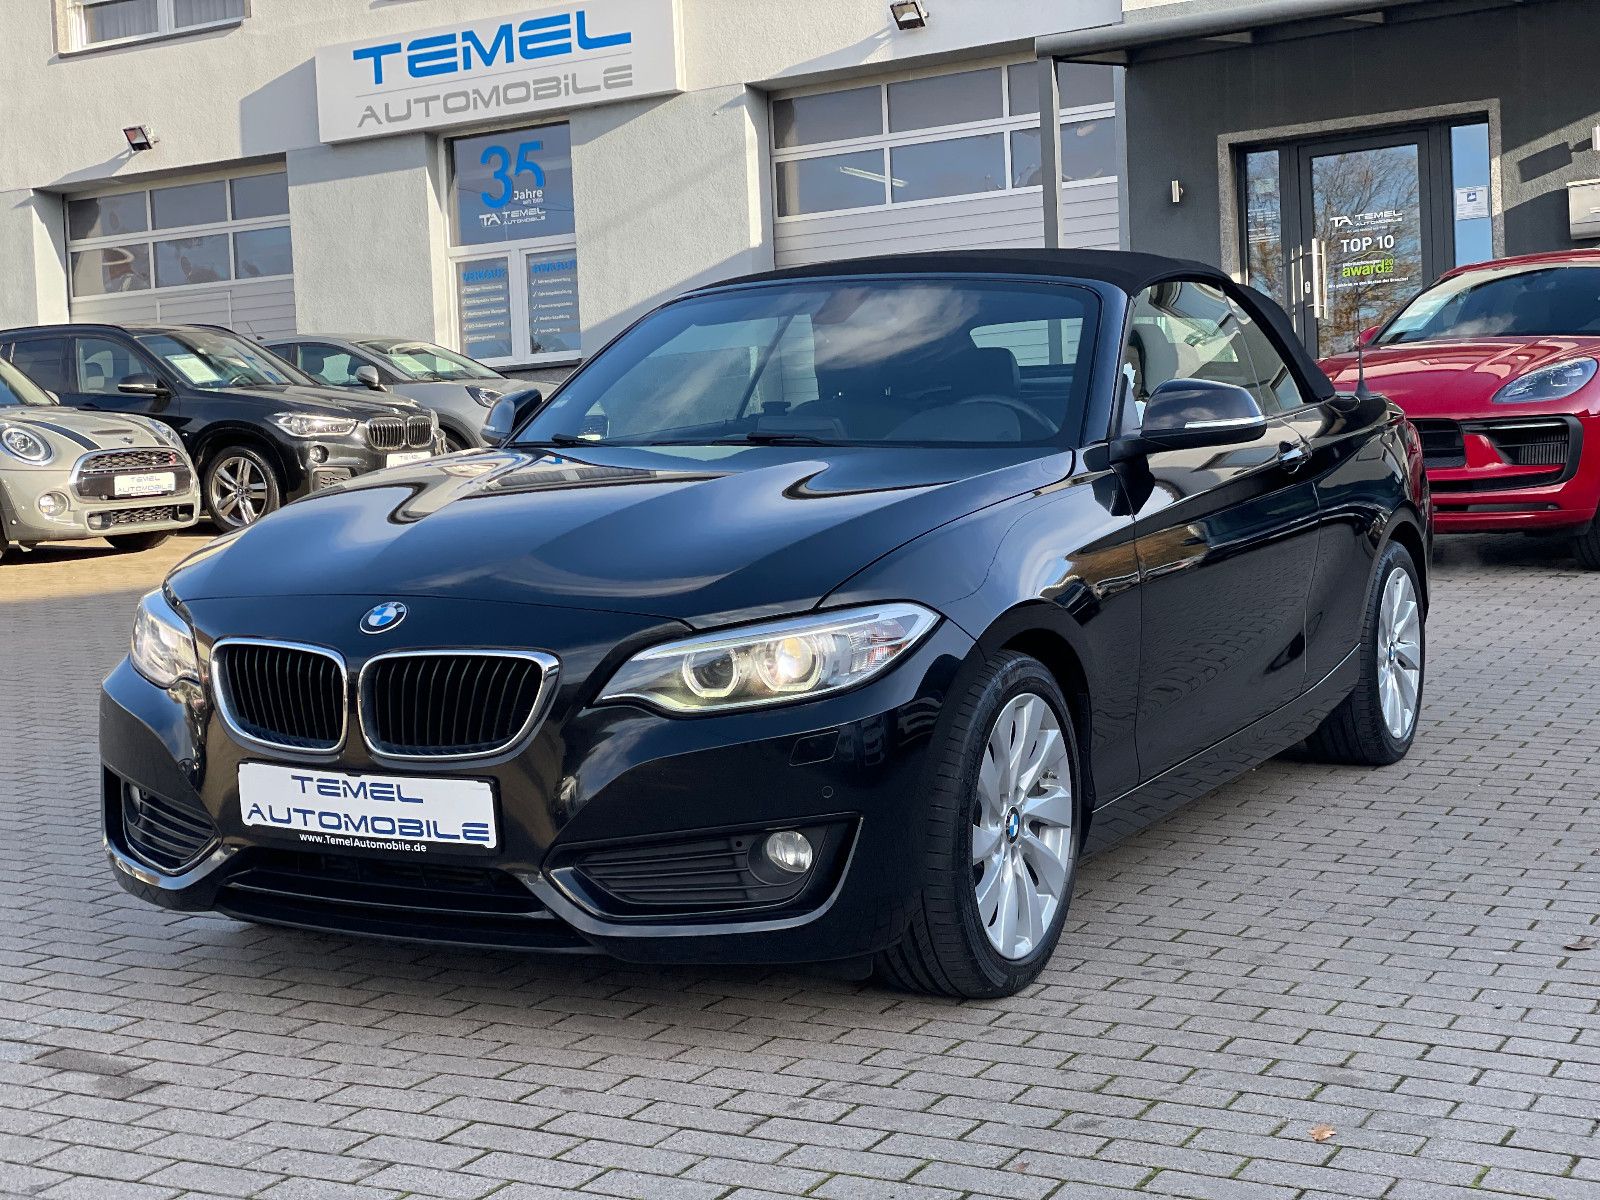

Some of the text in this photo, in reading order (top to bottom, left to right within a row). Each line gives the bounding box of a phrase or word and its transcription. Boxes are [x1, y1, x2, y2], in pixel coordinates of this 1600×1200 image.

[353, 10, 632, 85] TEMEL
[480, 140, 545, 208] 35
[514, 189, 543, 200] Jahre
[502, 207, 546, 218] TEMEL
[1355, 209, 1403, 220] TEMEL
[1340, 234, 1395, 253] TOP 10
[1342, 258, 1385, 278] award
[291, 774, 424, 804] TEMEL
[247, 803, 490, 842] AUTOMOBILE
[299, 833, 427, 852] www.TemelAutomobile.de
